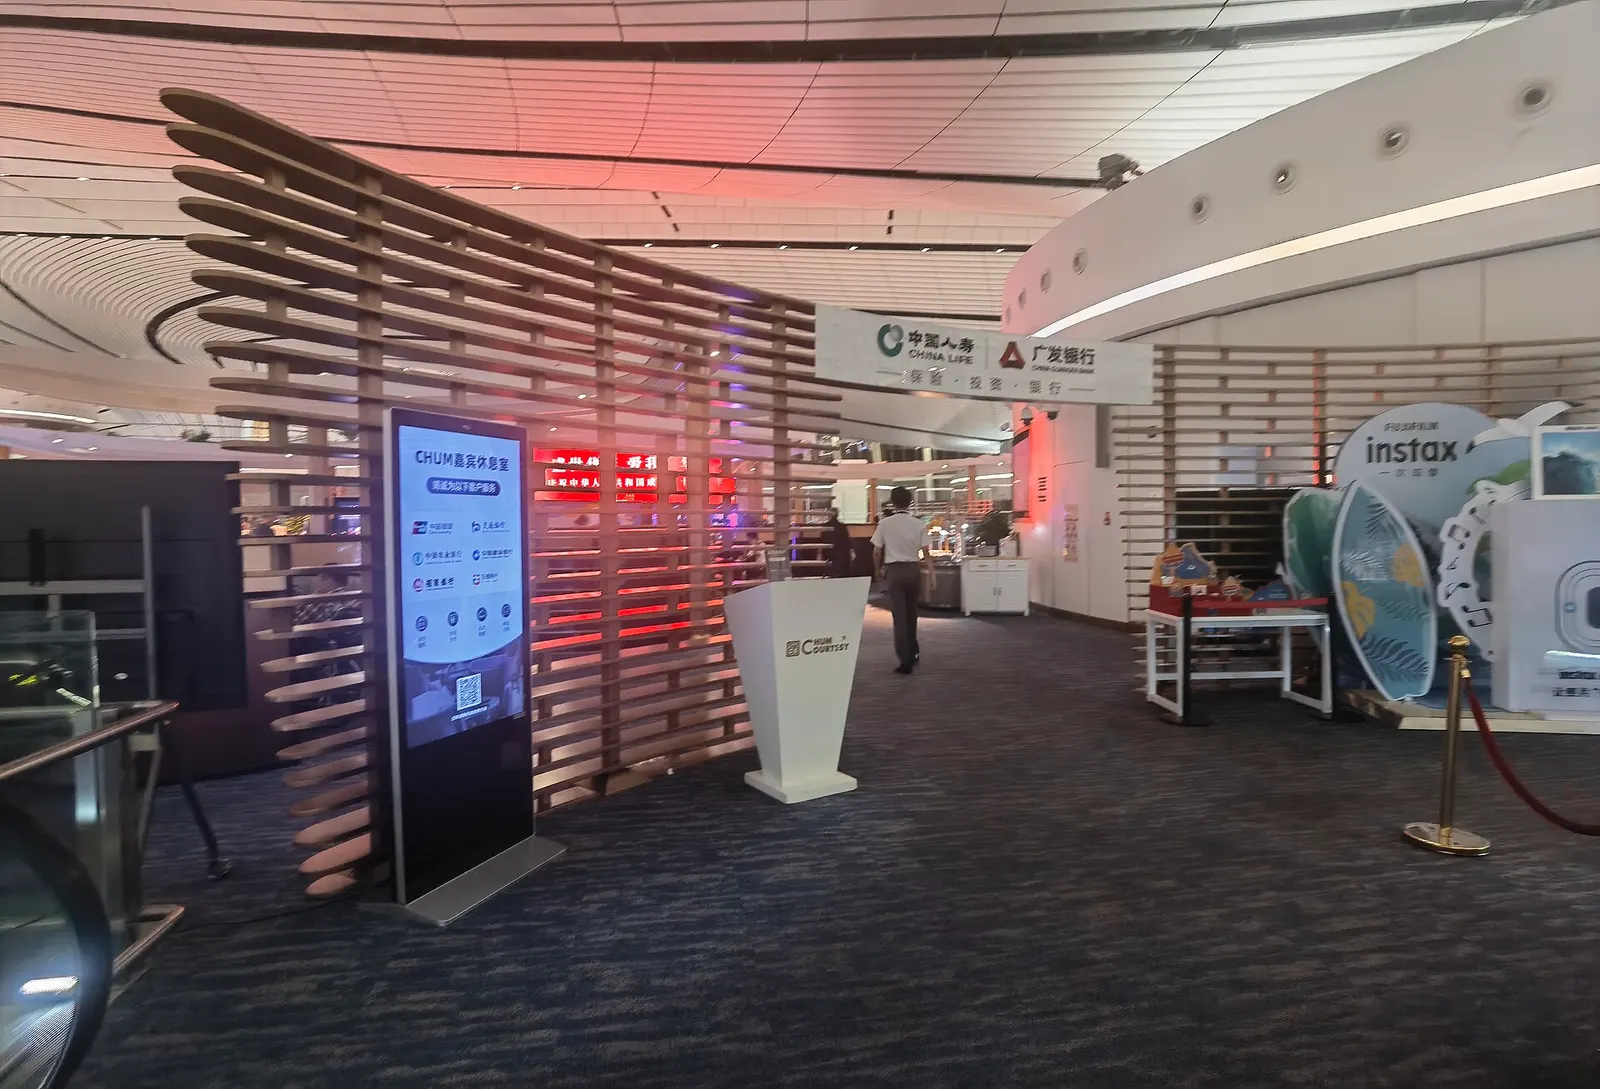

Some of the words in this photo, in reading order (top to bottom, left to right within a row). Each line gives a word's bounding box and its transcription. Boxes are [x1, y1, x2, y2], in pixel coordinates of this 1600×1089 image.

[908, 330, 975, 353] 中国人寿
[908, 349, 945, 361] CHINA
[948, 354, 974, 364] LIFE
[1032, 345, 1096, 365] 广发银行
[1384, 421, 1439, 432] FUJIFILM
[1366, 436, 1458, 463] instax
[415, 450, 510, 472] CHUM嘉宾休息室
